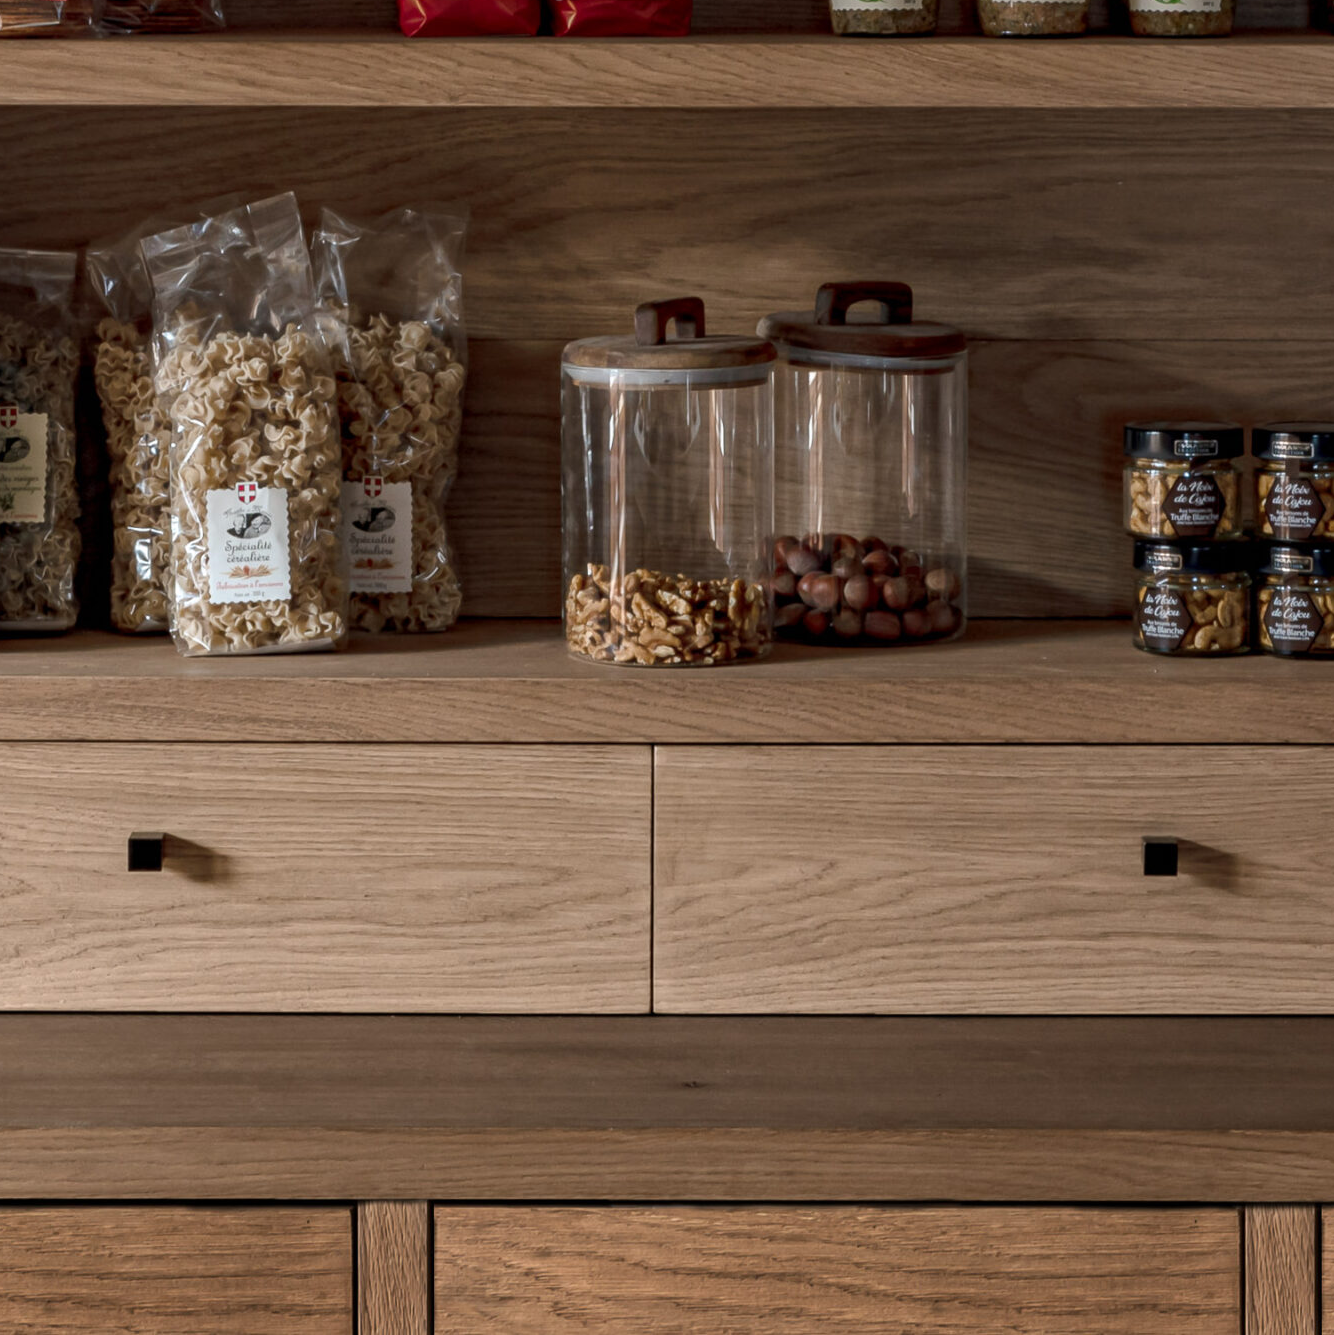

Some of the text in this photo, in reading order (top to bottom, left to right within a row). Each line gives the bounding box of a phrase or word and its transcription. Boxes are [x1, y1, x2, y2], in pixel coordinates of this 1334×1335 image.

[1188, 481, 1214, 492] Noix
[1285, 483, 1310, 494] Noix
[1174, 494, 1216, 505] de Cajou
[1272, 495, 1312, 508] de Cajou
[1193, 513, 1219, 521] Blanche
[1288, 516, 1316, 524] Blanche
[225, 540, 272, 556] Spécialité
[1155, 594, 1178, 605] Noix
[1283, 597, 1308, 607] Noix
[1144, 606, 1180, 618] de Cajou
[1271, 608, 1311, 621] de Cajou
[1158, 626, 1184, 635] Blanche
[1287, 628, 1315, 637] Blanche
